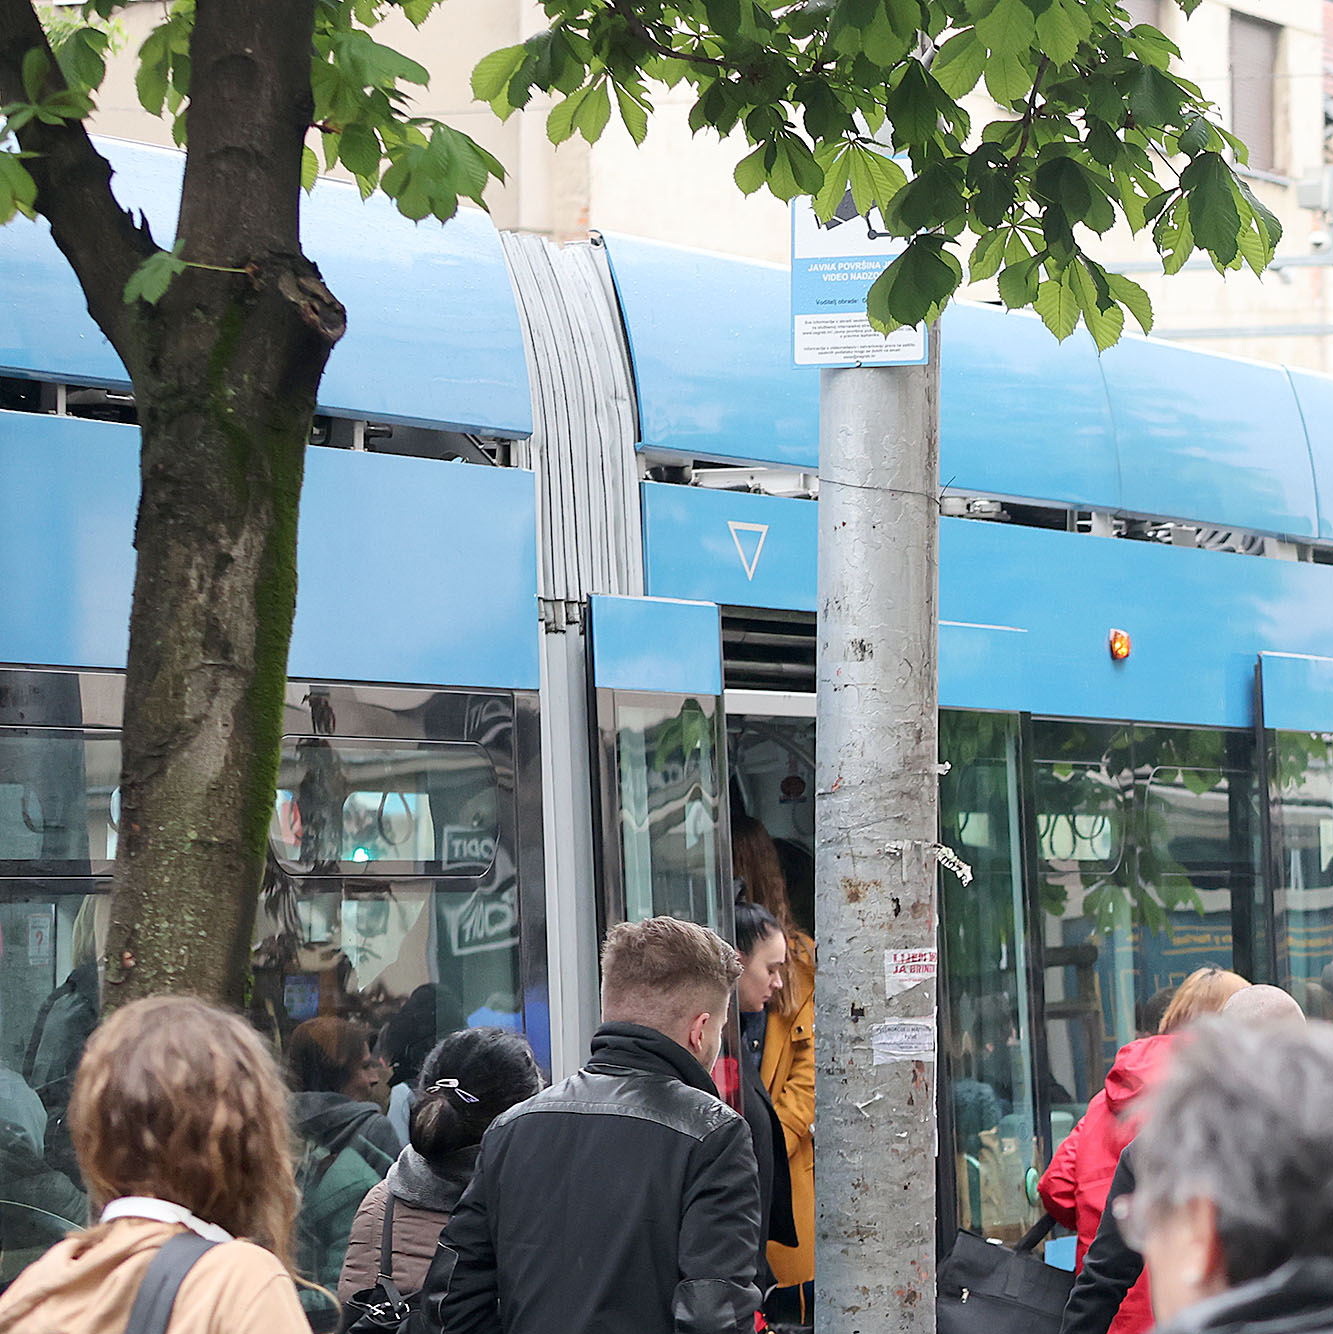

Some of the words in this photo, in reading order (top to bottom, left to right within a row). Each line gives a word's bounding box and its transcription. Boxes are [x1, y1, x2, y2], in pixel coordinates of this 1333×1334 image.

[808, 262, 836, 272] JAVNA
[838, 260, 881, 271] POVRŠINA
[822, 274, 848, 282] VIDEO
[850, 272, 882, 281] NADZO
